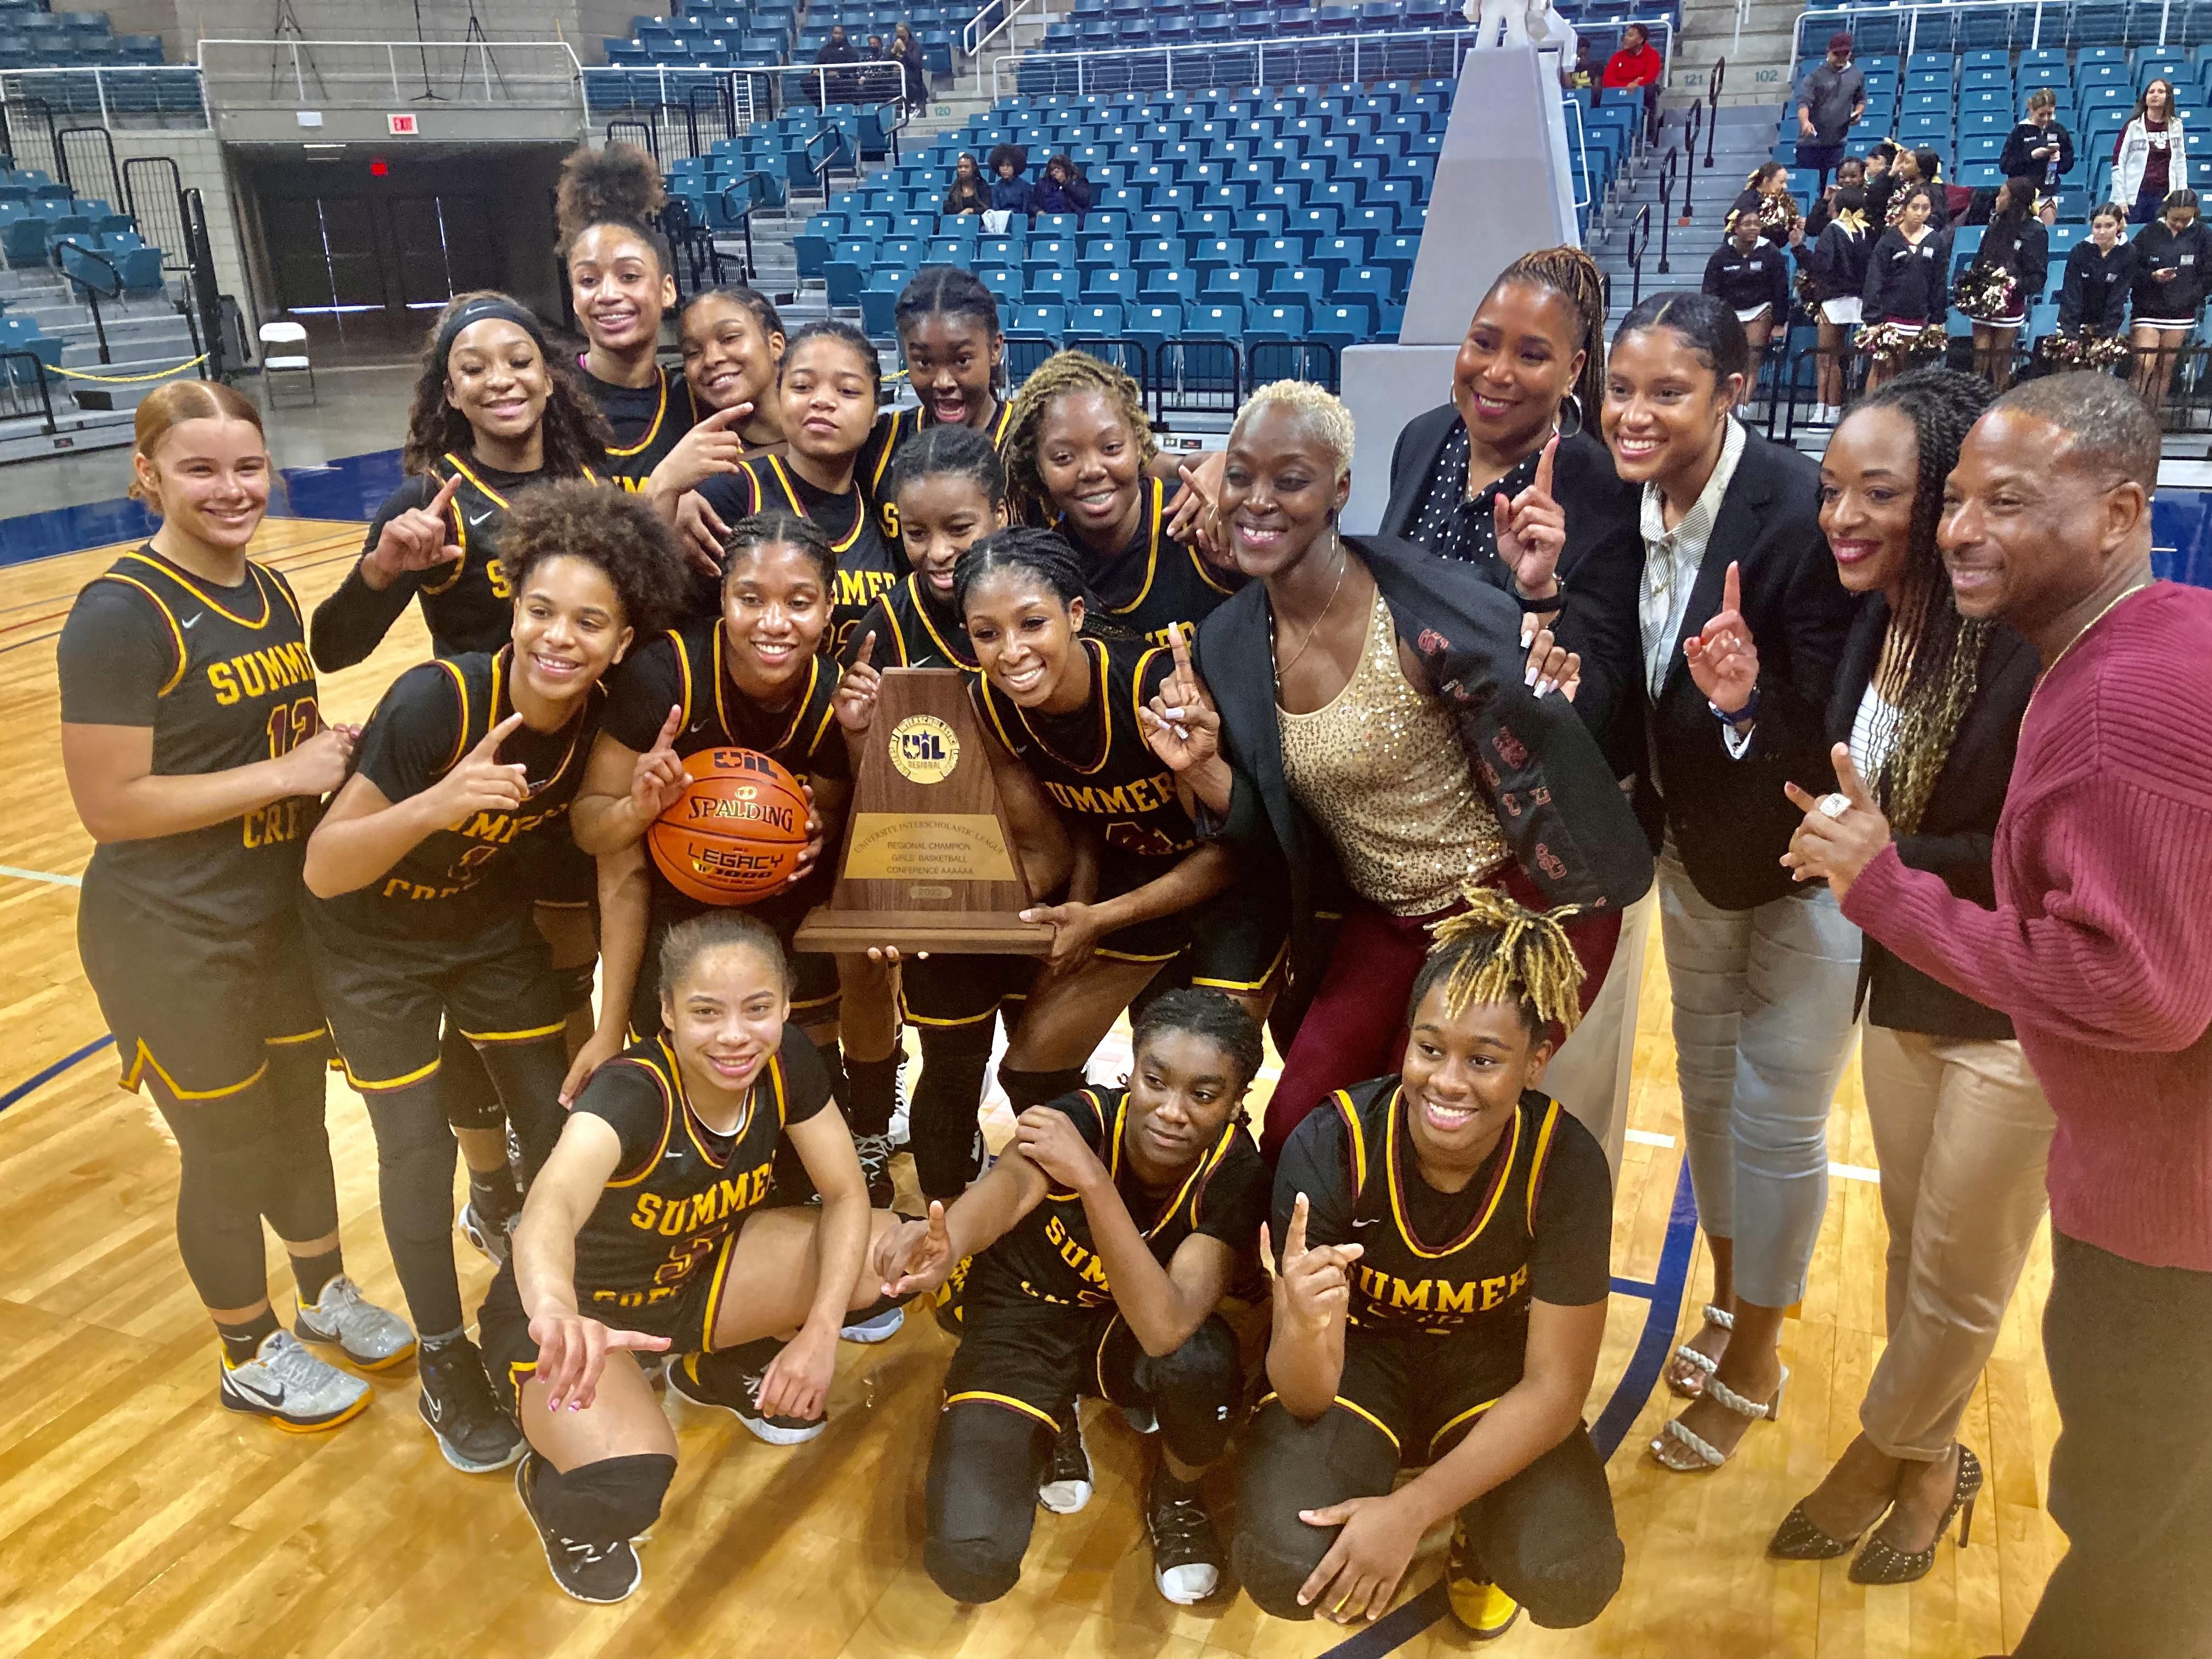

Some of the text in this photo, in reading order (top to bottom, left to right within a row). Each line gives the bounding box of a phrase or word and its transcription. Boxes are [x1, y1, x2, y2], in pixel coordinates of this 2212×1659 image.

[1684, 74, 1703, 86] 121
[1756, 69, 1778, 82] 102
[934, 106, 951, 116] 120
[689, 795, 793, 833] SPALDING
[853, 820, 1006, 856] UNIVERSITY INTERSCHOLASTIC LEAGUE
[887, 842, 971, 851] REGIONAL CHAMPION
[687, 842, 784, 870] LEGACY
[918, 854, 967, 863] BASKETBALL
[886, 866, 939, 874] CONFERENCE
